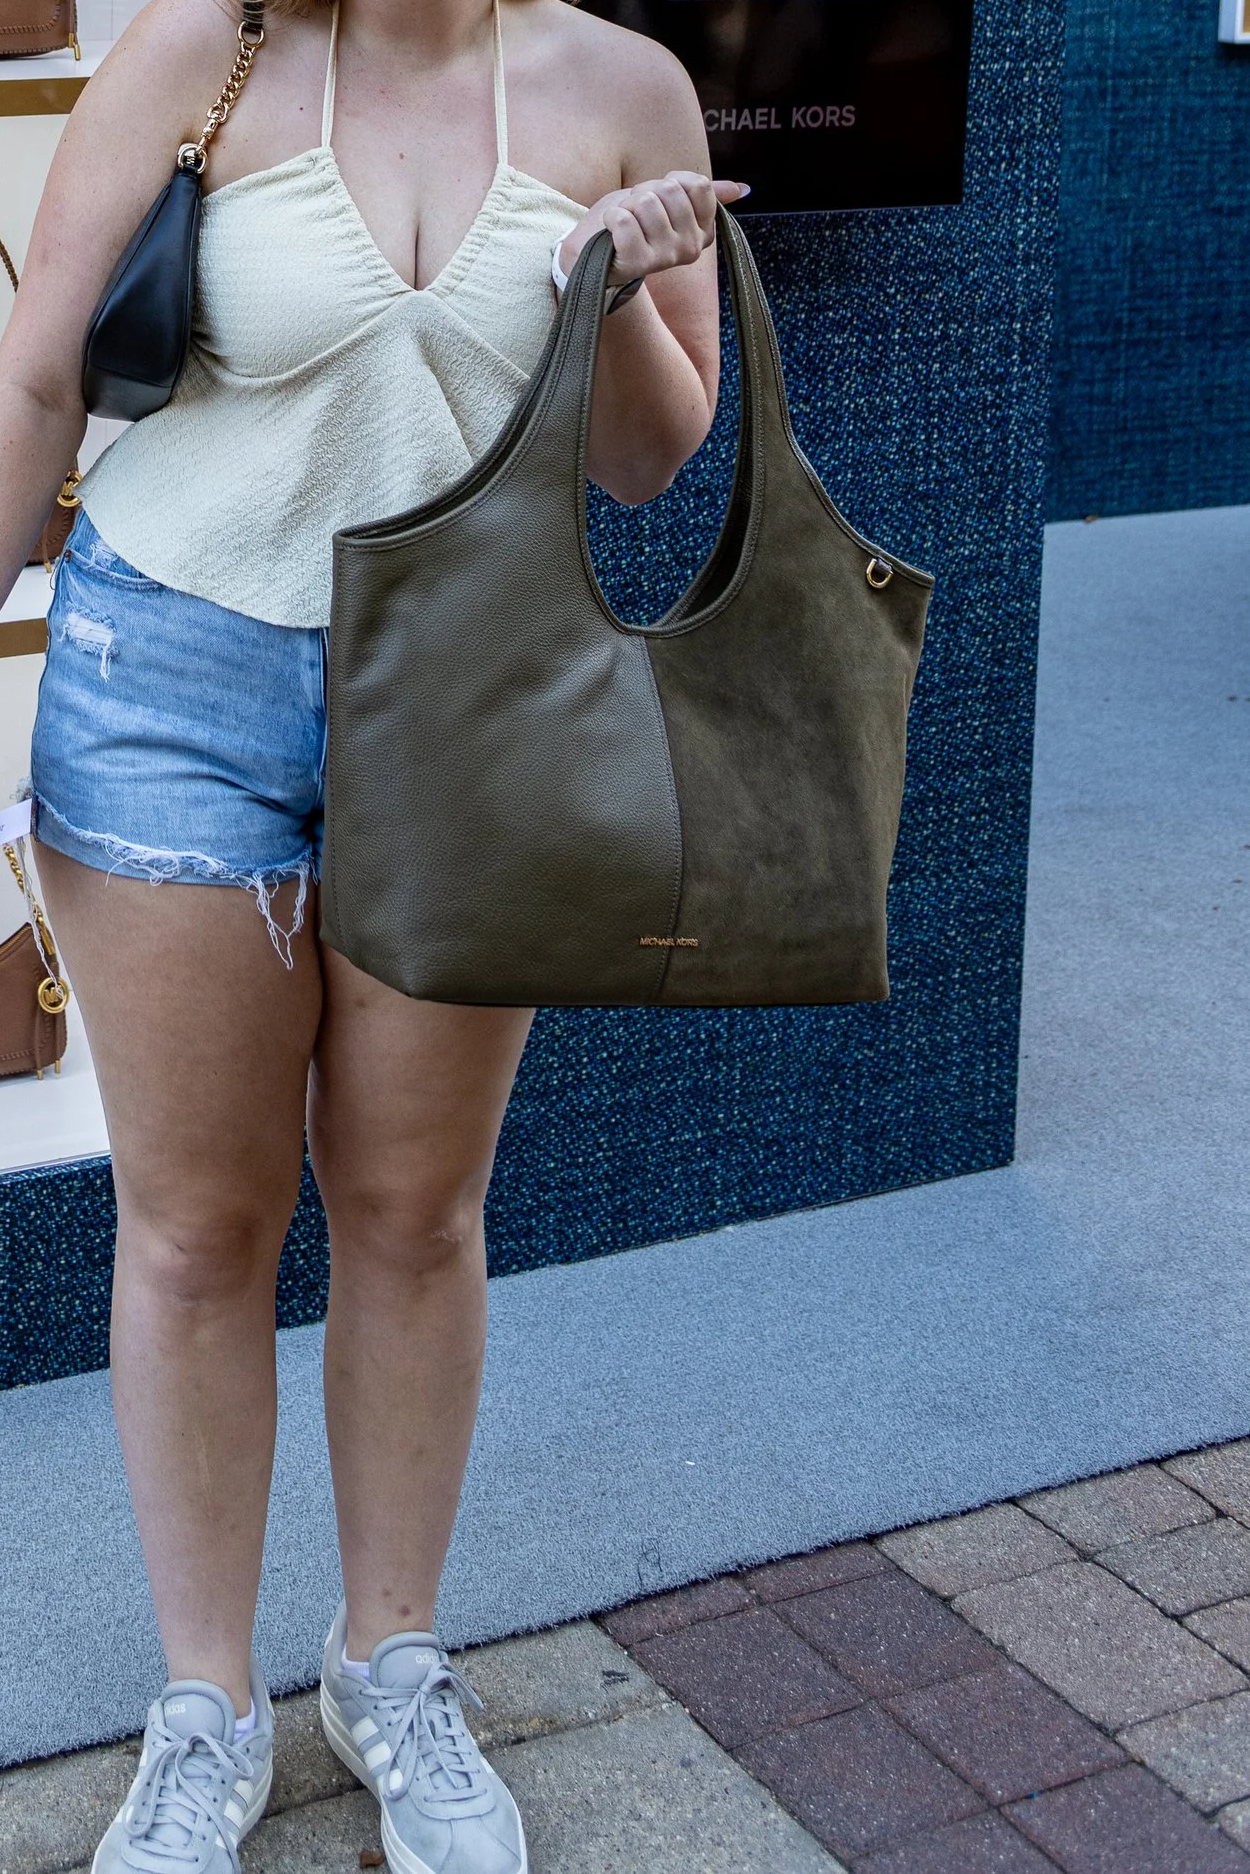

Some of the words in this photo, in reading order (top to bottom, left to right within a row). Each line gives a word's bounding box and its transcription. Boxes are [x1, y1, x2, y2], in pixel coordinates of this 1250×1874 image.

[791, 104, 856, 130] KORS
[639, 936, 675, 947] MICHAEL
[675, 937, 699, 947] KORS
